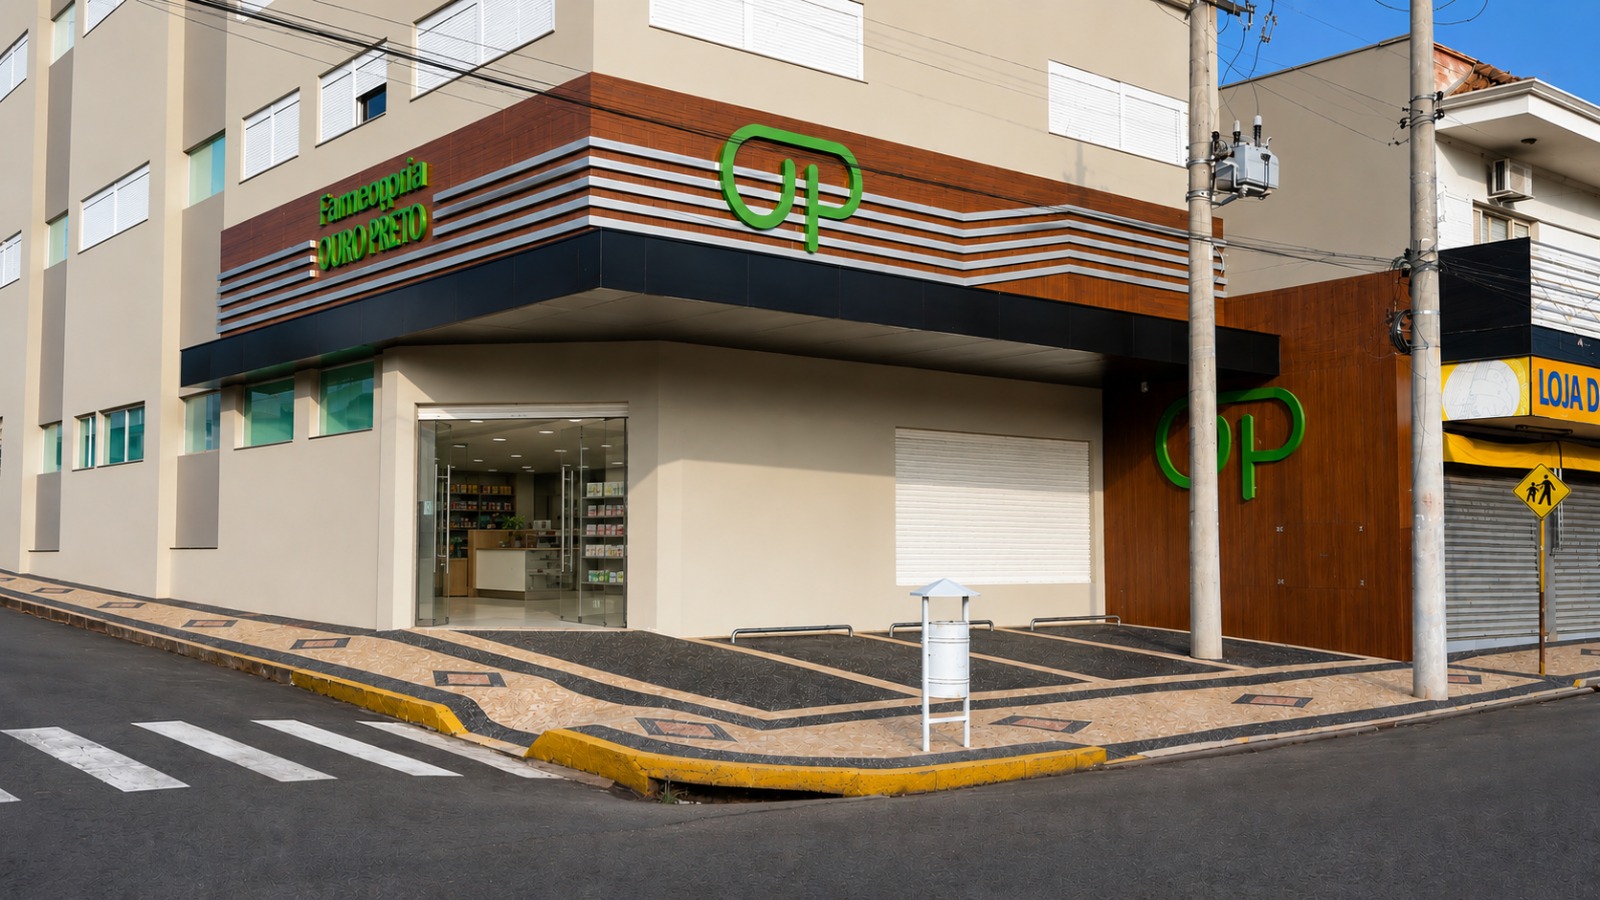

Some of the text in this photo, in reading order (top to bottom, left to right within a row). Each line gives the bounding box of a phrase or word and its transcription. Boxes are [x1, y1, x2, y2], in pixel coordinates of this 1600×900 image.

[318, 203, 427, 270] OURO PRETO
[1538, 368, 1583, 411] LOJA
